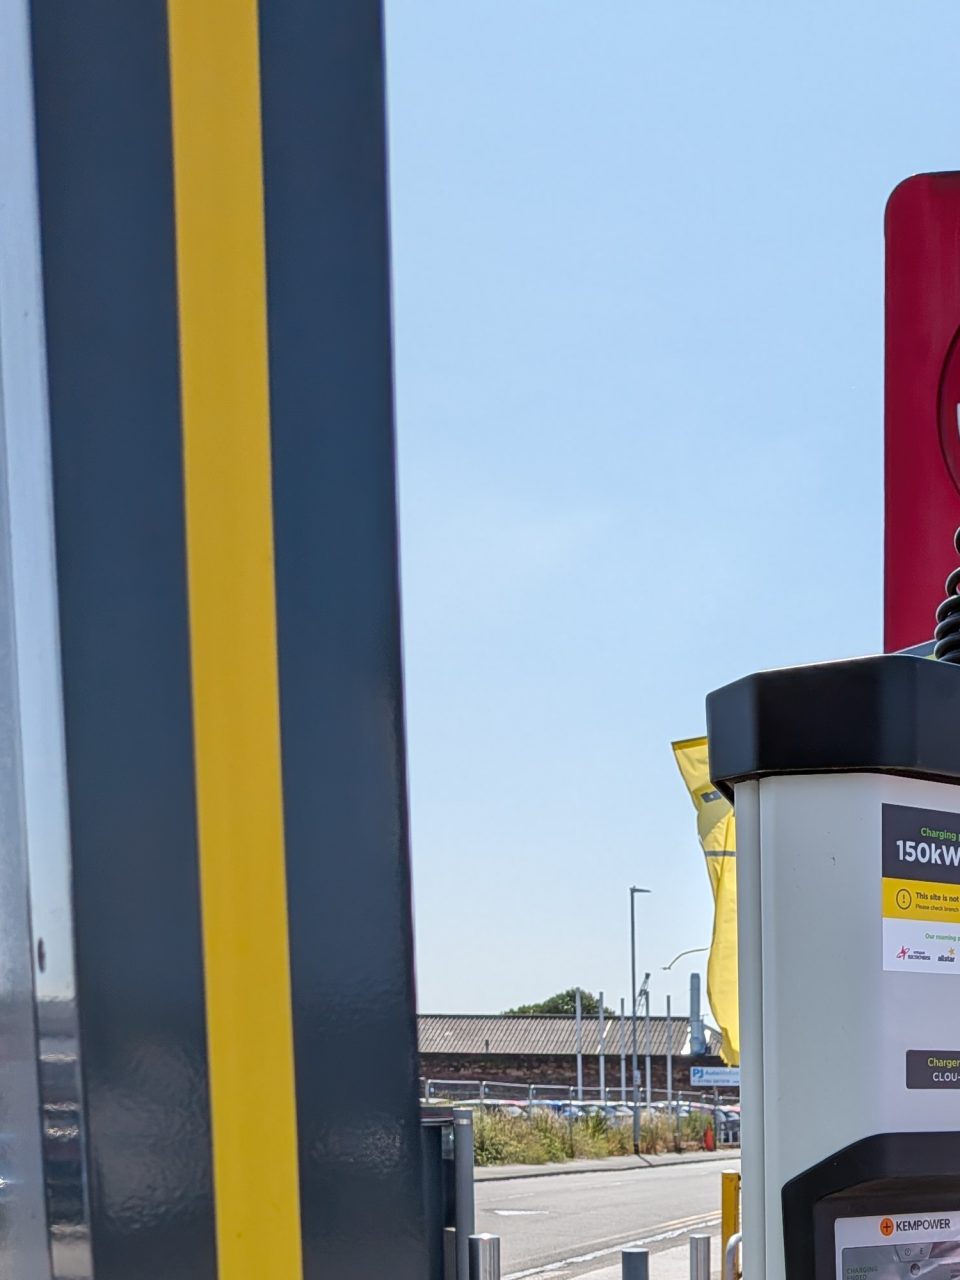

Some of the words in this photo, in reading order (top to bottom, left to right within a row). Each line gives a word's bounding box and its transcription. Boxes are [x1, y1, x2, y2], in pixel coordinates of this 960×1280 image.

[920, 827, 957, 841] Charging
[915, 892, 928, 900] This
[927, 1057, 960, 1069] Charger
[896, 1218, 951, 1232] KEMPOWER
